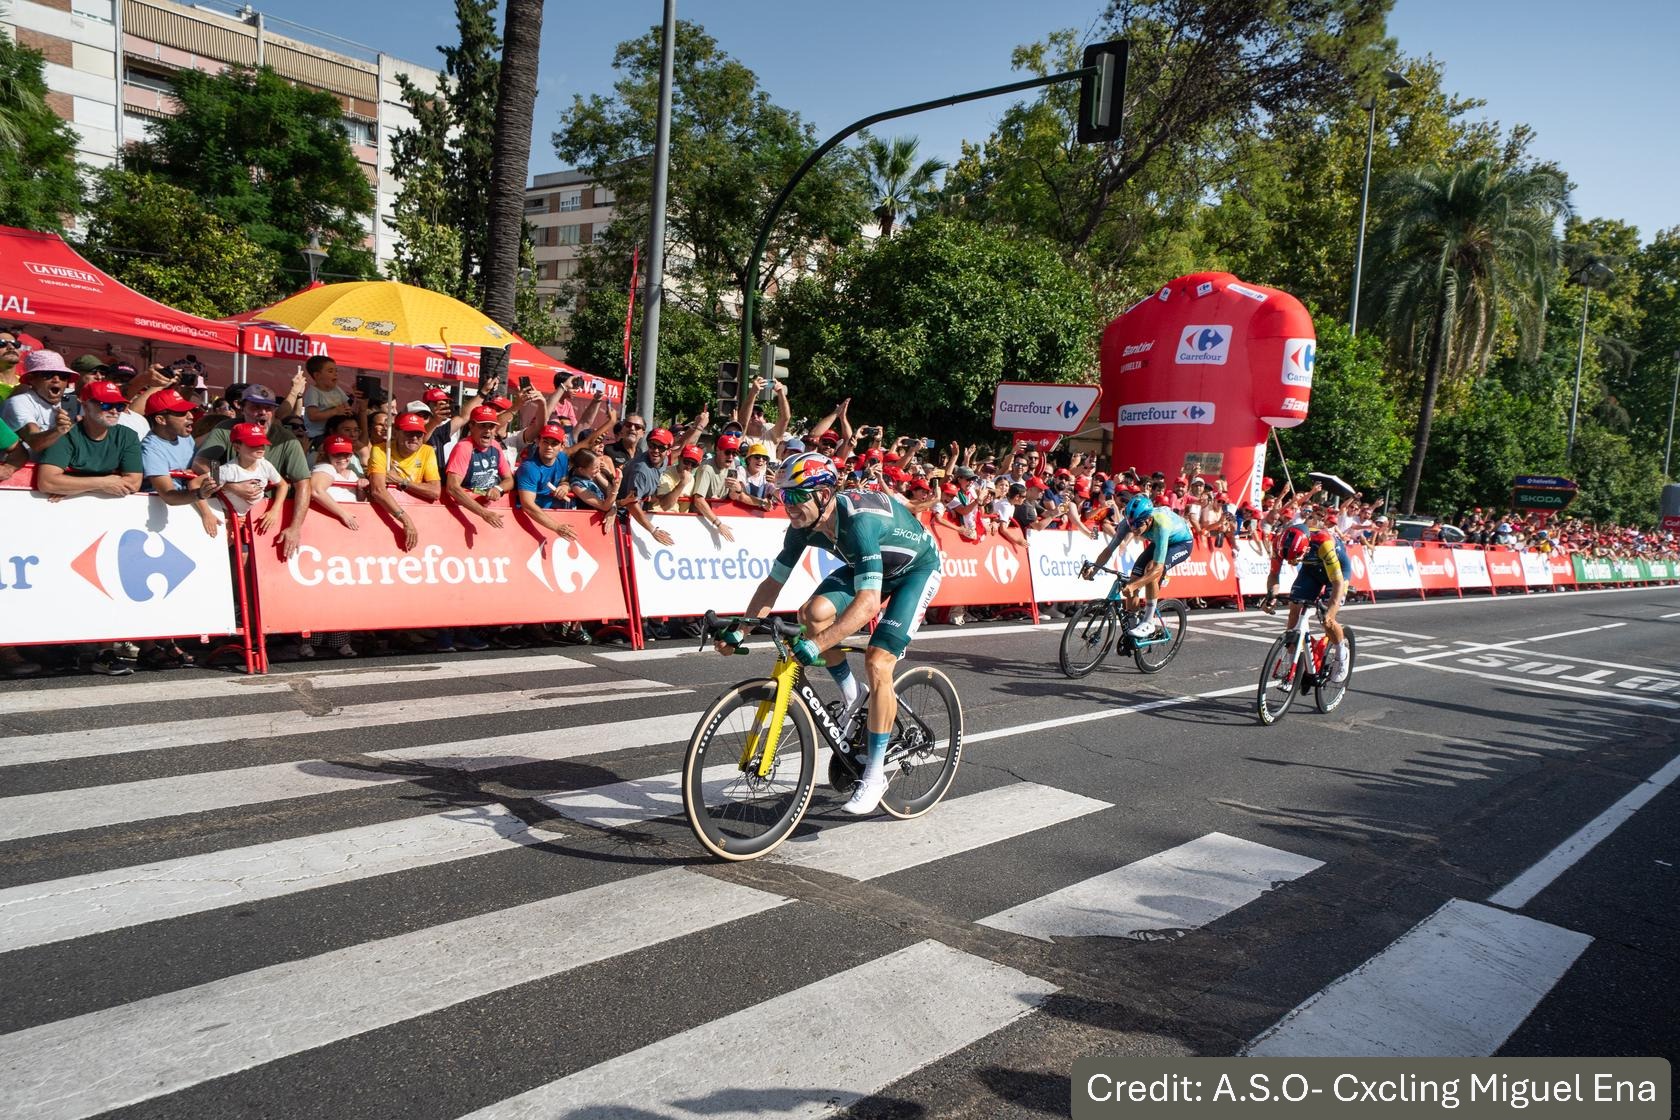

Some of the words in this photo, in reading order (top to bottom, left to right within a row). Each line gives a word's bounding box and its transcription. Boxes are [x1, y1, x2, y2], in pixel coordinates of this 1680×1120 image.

[49, 266, 97, 283] VUELTA
[134, 316, 218, 339] santinicycling.com
[254, 333, 273, 352] LA
[275, 337, 329, 357] VUELTA
[425, 356, 466, 378] OFFICIAL
[1179, 353, 1222, 362] Carrefour
[1000, 400, 1053, 415] Carrefour
[1120, 407, 1178, 422] Carrefour
[287, 544, 511, 586] Carrefour
[698, 713, 722, 754] RESERVE
